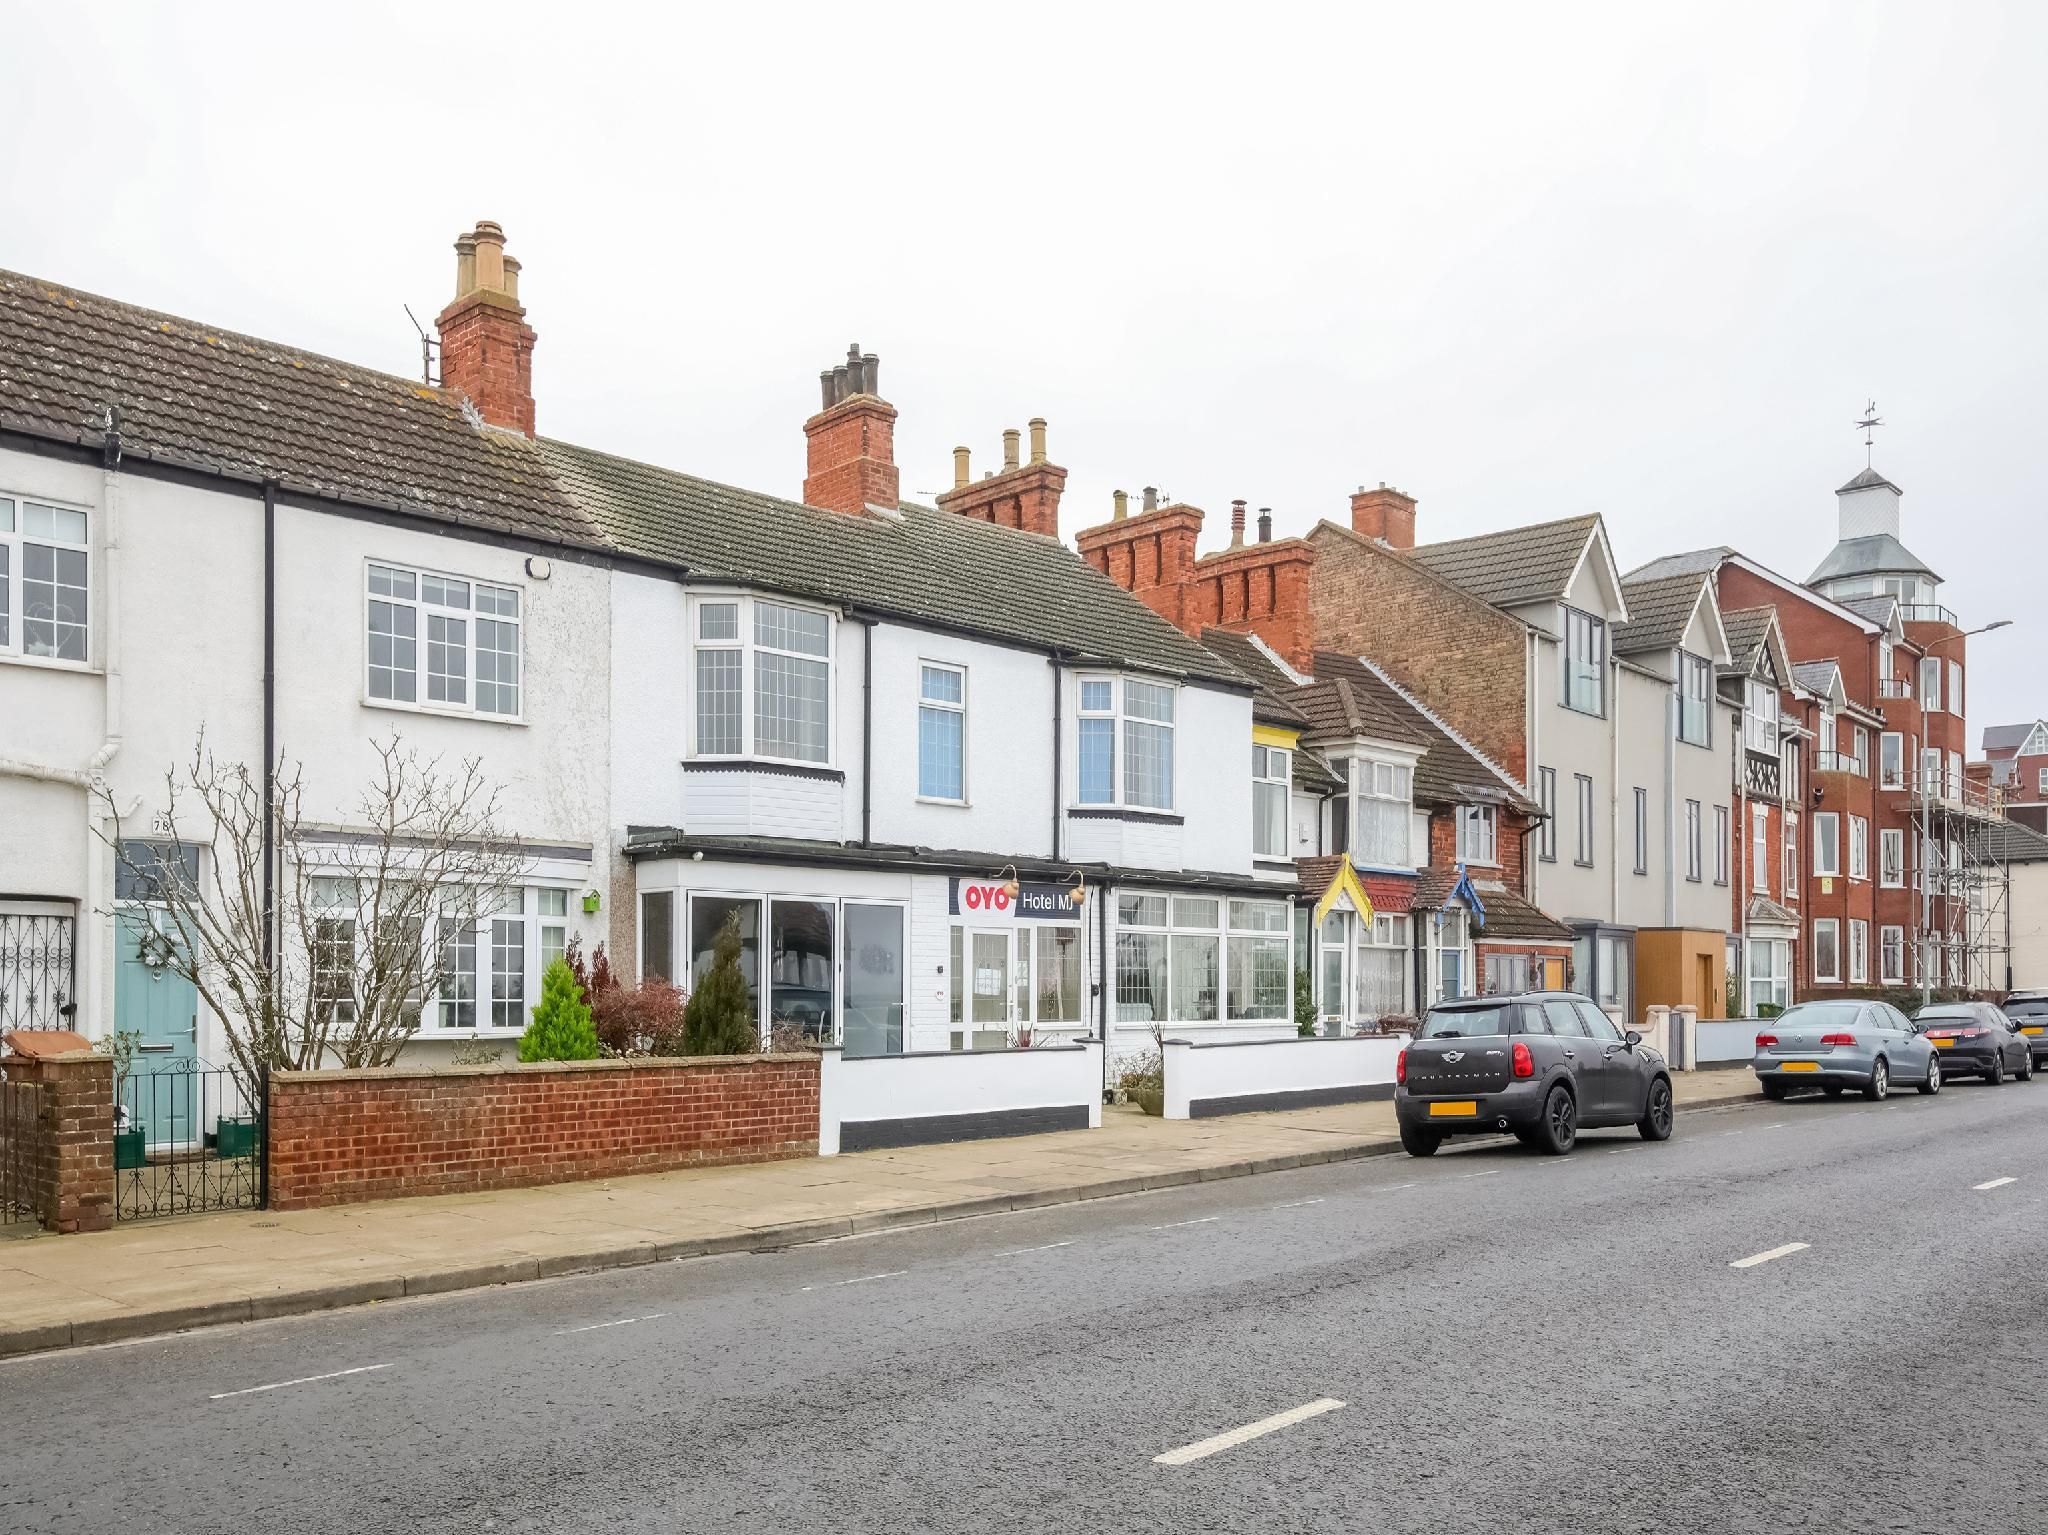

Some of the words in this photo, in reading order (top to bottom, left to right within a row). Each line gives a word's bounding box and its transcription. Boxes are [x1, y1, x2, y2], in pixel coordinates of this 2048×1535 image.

[154, 820, 169, 831] 78
[966, 885, 1010, 911] OYO
[1023, 892, 1055, 910] Hotel
